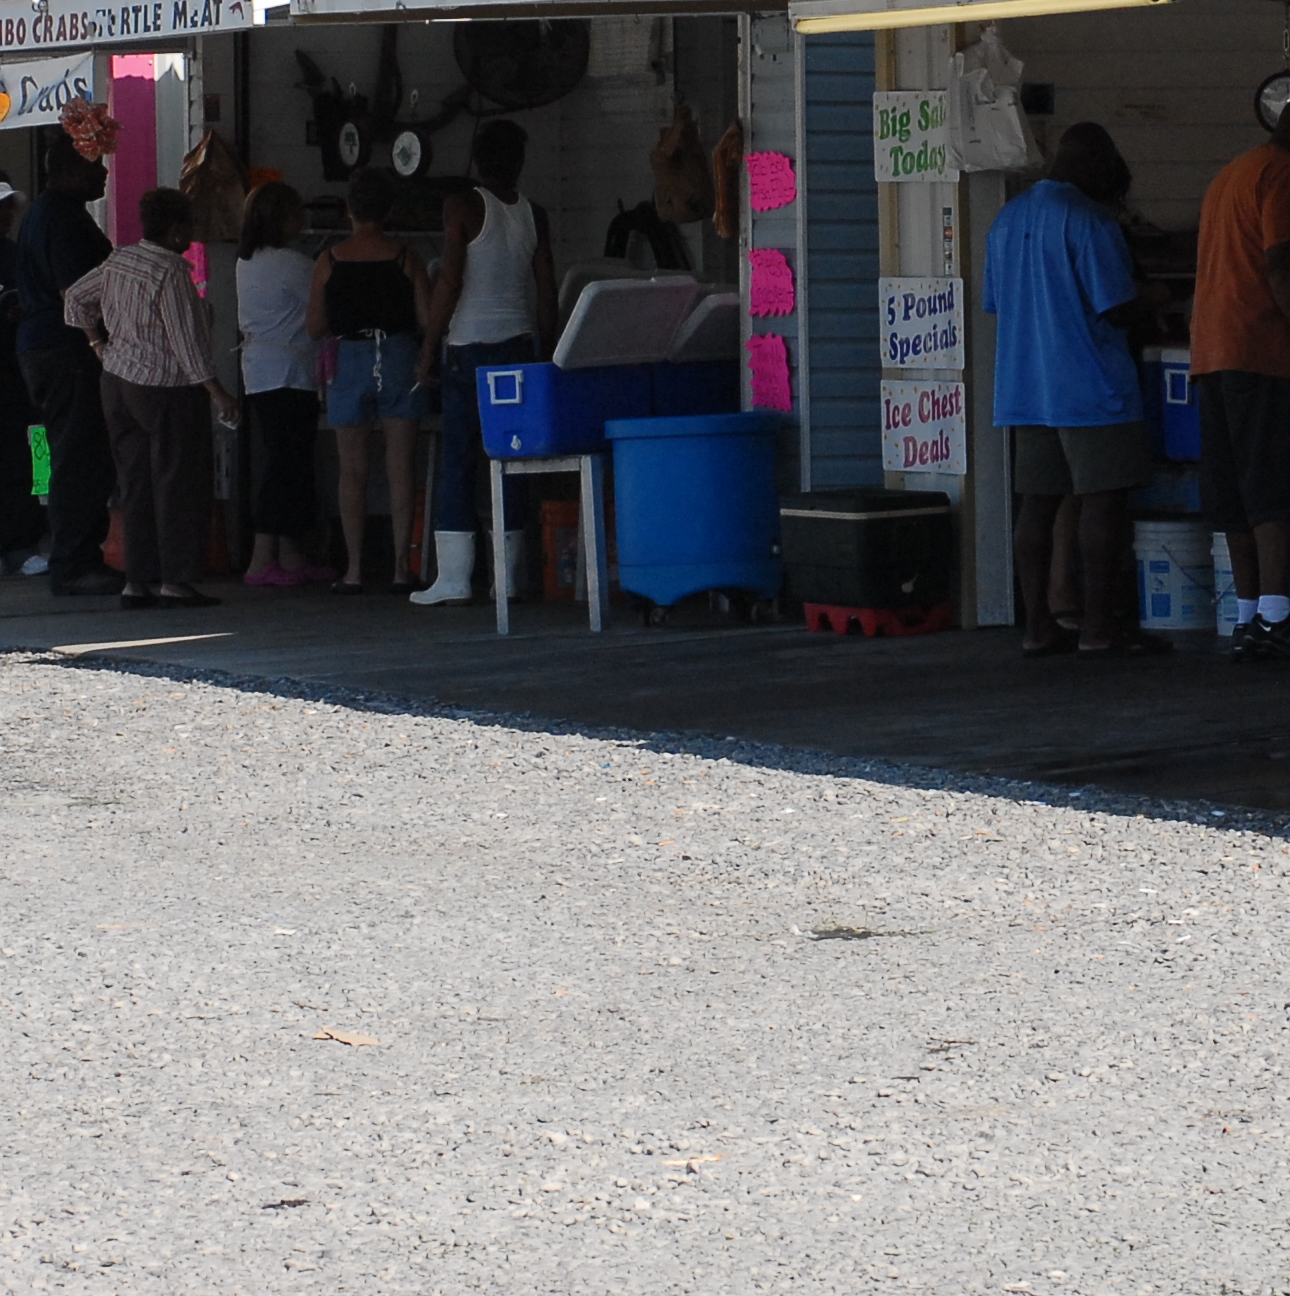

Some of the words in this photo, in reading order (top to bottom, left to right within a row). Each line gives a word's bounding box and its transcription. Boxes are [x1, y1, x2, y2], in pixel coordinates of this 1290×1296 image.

[32, 12, 88, 43] CRABS
[879, 106, 911, 143] Big
[890, 140, 946, 177] Today
[887, 295, 897, 326] 5
[903, 282, 955, 322] Pound
[888, 320, 958, 365] Specials
[884, 395, 912, 431] Ice
[918, 383, 963, 424] Chest
[903, 429, 950, 469] Deals
